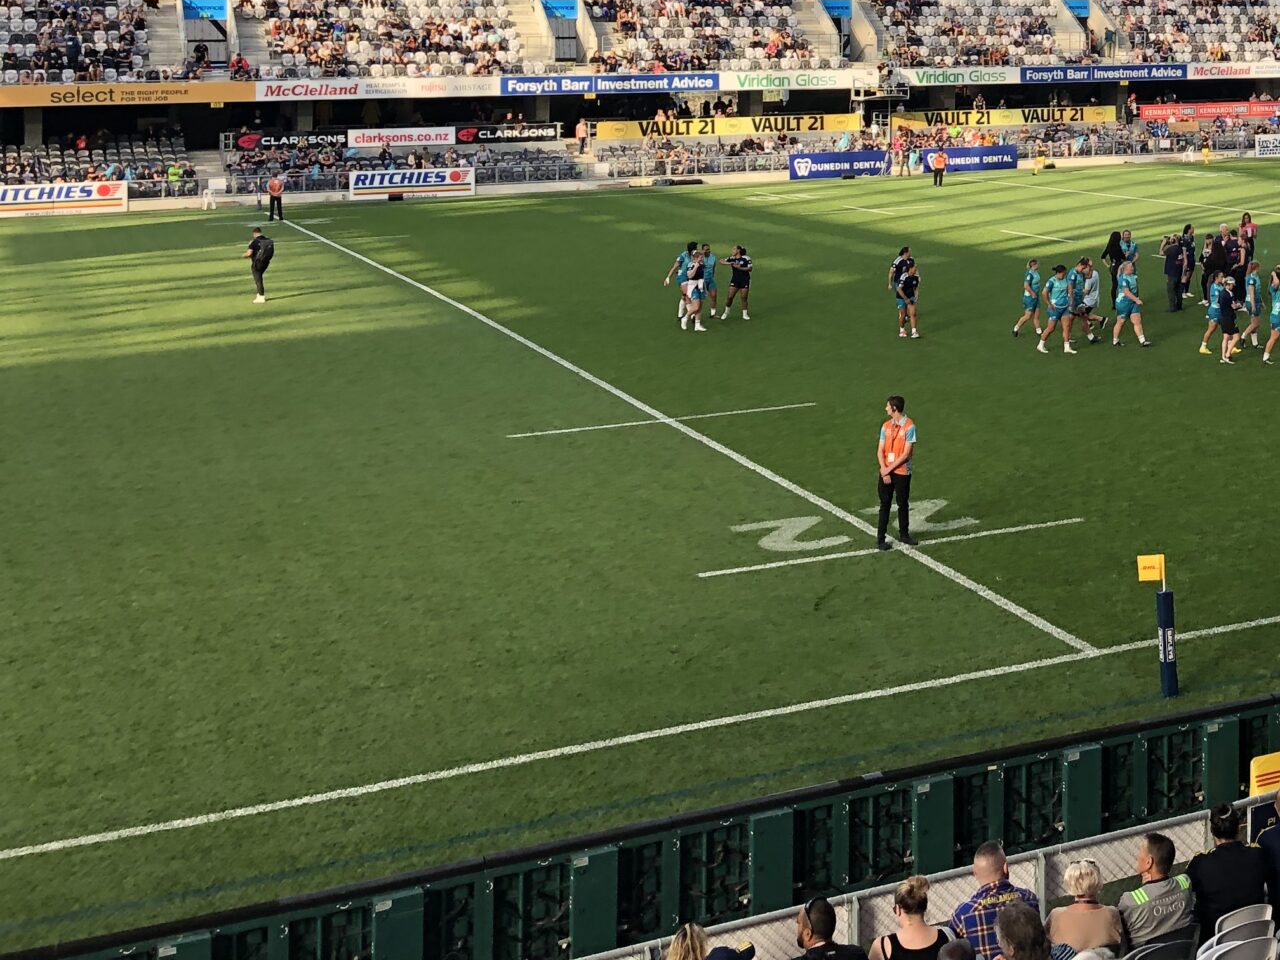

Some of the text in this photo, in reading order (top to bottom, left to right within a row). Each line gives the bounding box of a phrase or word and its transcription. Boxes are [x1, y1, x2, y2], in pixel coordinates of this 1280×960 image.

[916, 70, 1006, 84] Viridian Glass
[1026, 67, 1183, 83] Forsyth Barr Investment Advice
[1193, 65, 1251, 77] McClelland
[507, 76, 714, 93] Forsyth Barr Investment Advice
[737, 74, 837, 88] Viridian Glass
[51, 86, 115, 103] select
[264, 83, 359, 97] McClelland
[1021, 108, 1084, 123] VAULT 21
[1181, 107, 1195, 116] HIRE
[1234, 105, 1249, 114] HIRE
[751, 115, 825, 133] VAULT 21
[924, 110, 991, 127] VAULT 21
[479, 128, 556, 139] CLARKSONS
[638, 119, 716, 137] VAULT 21
[261, 135, 346, 146] CLARKSONS
[355, 132, 449, 144] clarksons.co.nz
[811, 160, 885, 172] DUNEDIN DENTAL
[948, 155, 1012, 166] UNEDIN DENTAL
[354, 171, 447, 186] RITCHIES
[0, 185, 93, 202] ITCHIES
[1153, 901, 1185, 916] OTAGO
